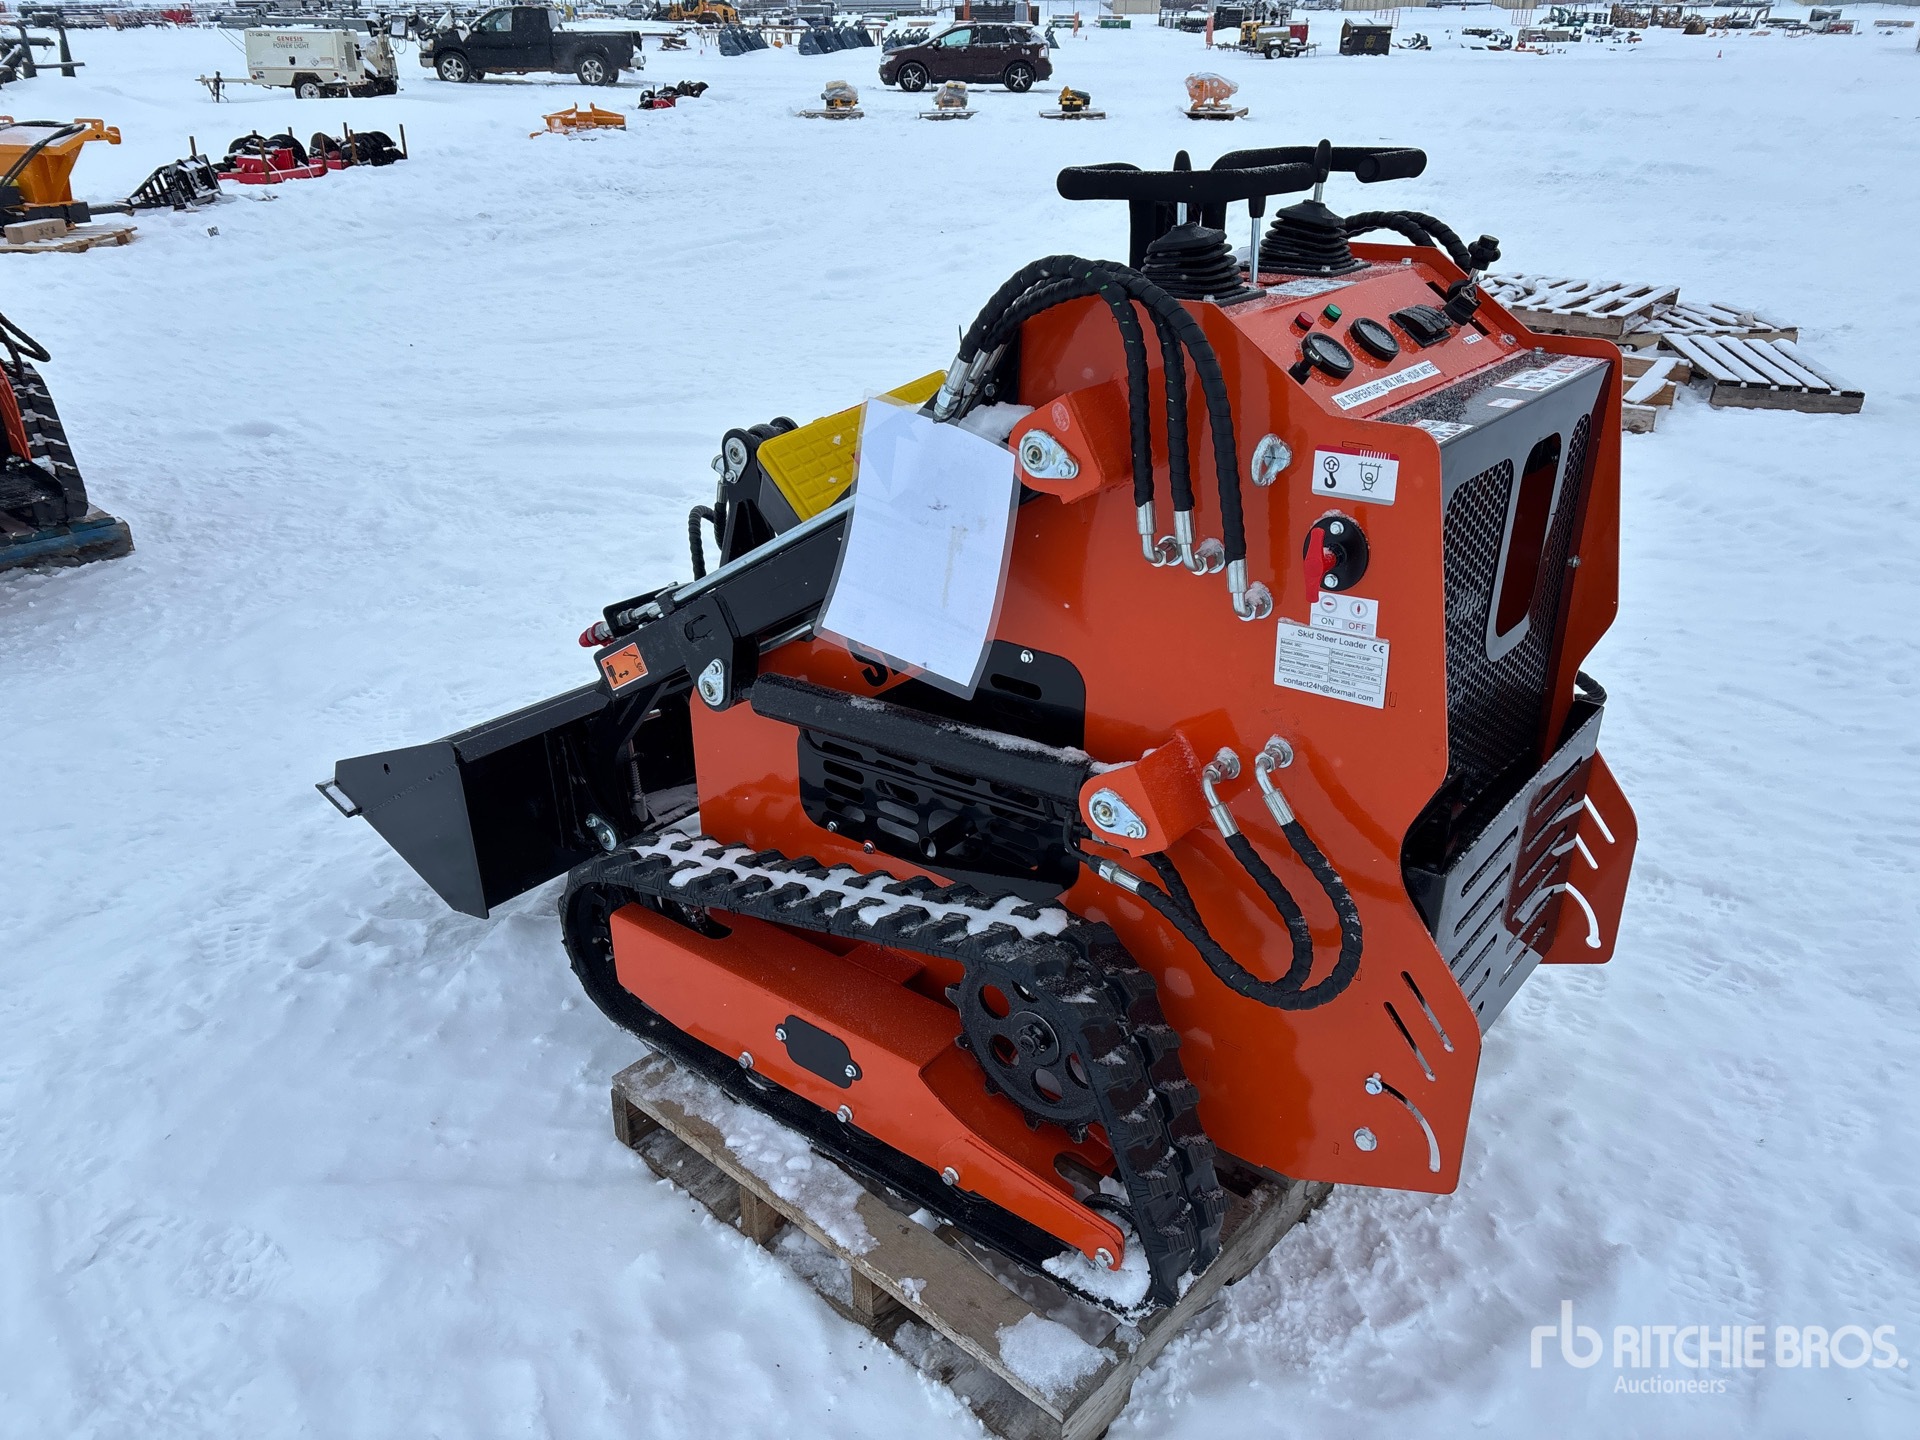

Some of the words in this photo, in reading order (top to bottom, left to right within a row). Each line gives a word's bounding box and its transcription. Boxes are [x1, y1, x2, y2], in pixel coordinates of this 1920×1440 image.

[1347, 383, 1385, 403] TEMPERATURE
[1381, 374, 1408, 389] VOLTAGE
[1405, 368, 1422, 380] HOUR
[1321, 617, 1334, 626] ON
[1348, 622, 1367, 631] OFF
[1297, 629, 1314, 639] Skid
[1316, 633, 1337, 644] Steer
[1339, 638, 1367, 650] Loader
[1283, 677, 1374, 702] contact24h@foxmail.com
